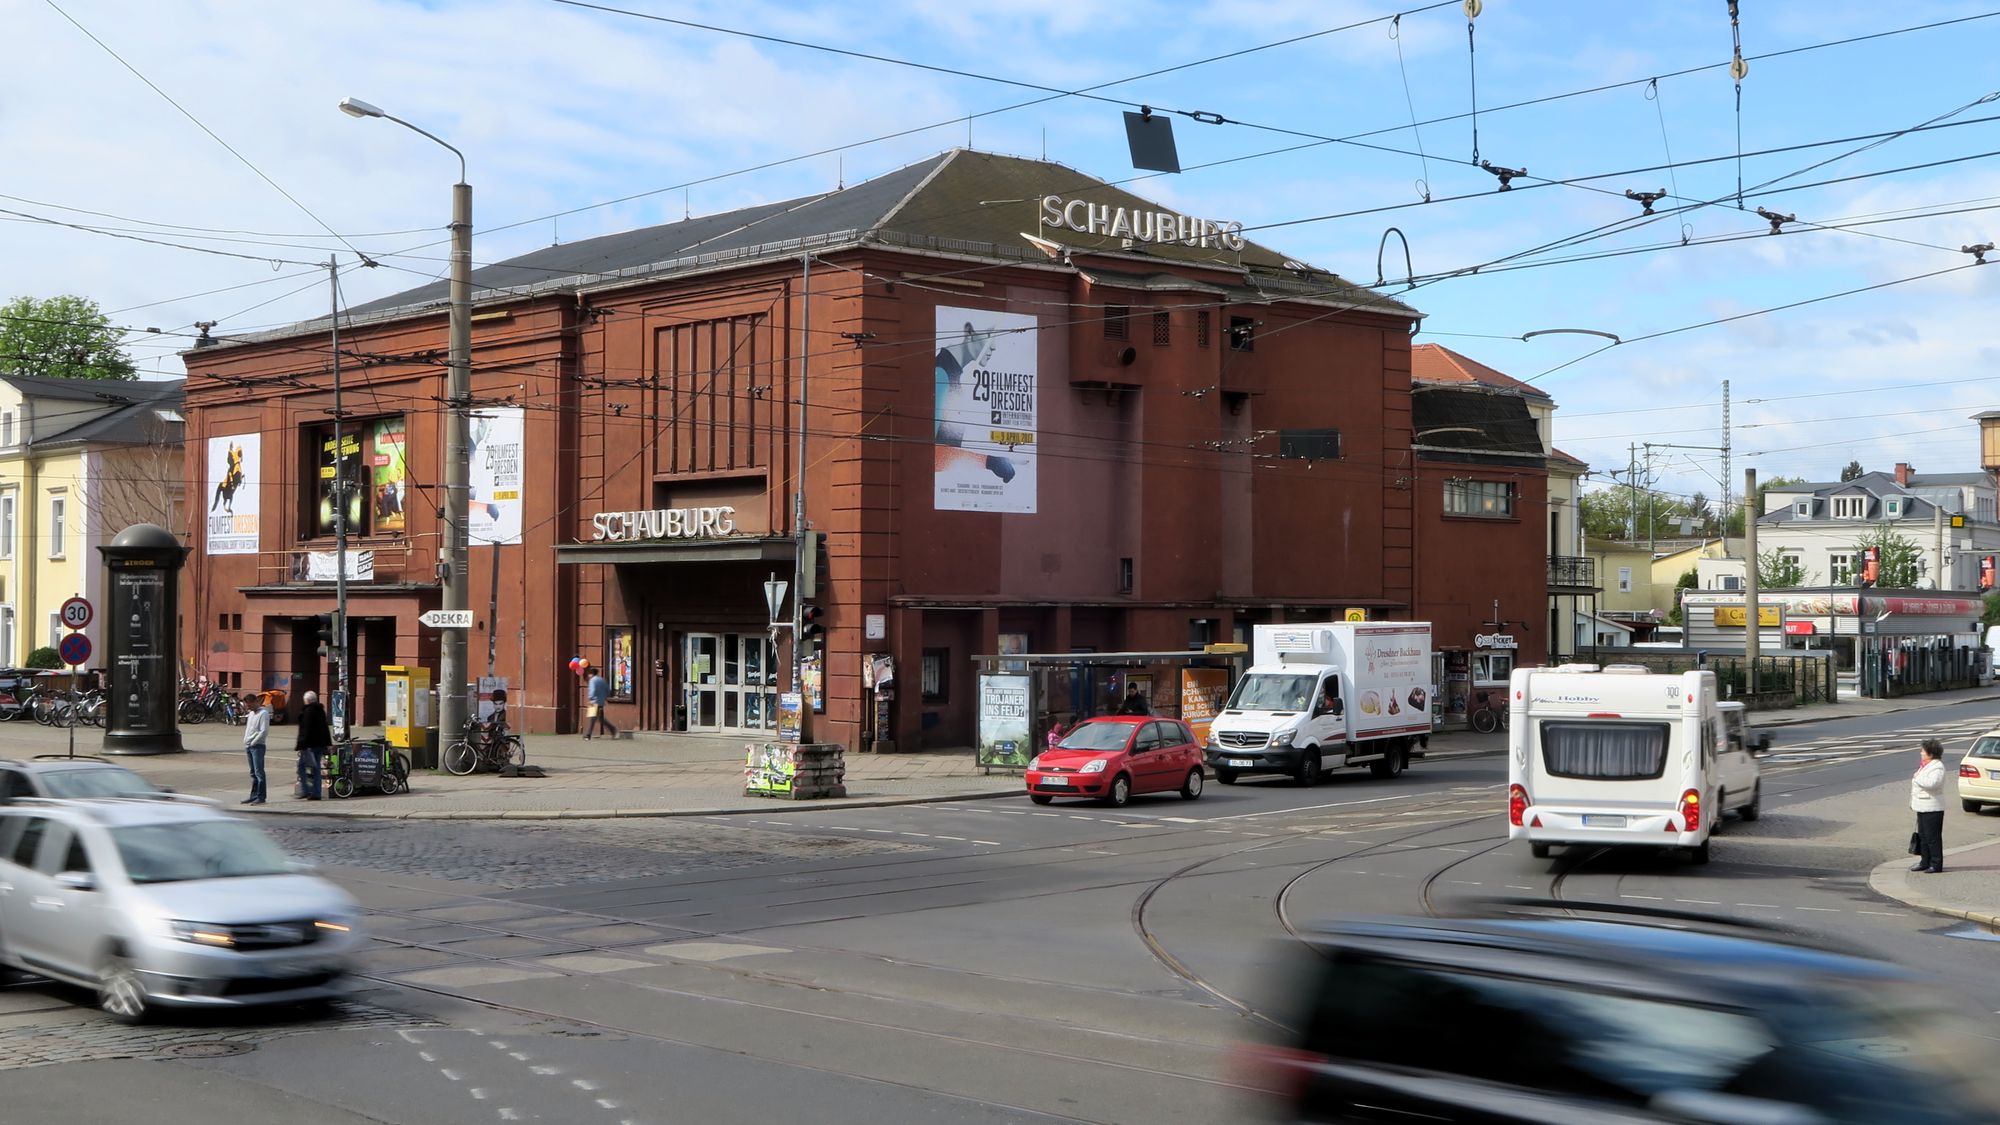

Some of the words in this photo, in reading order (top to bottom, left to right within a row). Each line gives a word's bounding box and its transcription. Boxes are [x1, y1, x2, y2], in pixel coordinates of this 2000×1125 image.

[1042, 195, 1245, 252] SCHAUBURG
[973, 369, 990, 402] 29
[991, 371, 1034, 393] FILMFEST
[991, 391, 1033, 412] DRESDEN
[485, 445, 495, 470] 29
[494, 443, 519, 459] FILMFEST
[494, 459, 518, 475] DRESDEN
[208, 515, 234, 535] FILMFEST
[234, 514, 257, 534] DRESDEN
[592, 506, 736, 541] SCHAUBURG
[67, 606, 86, 621] 30
[432, 613, 470, 624] DEKRA
[1183, 687, 1211, 696] SCHRITT
[1187, 680, 1199, 688] EIN
[986, 694, 1024, 705] TROJANER
[1188, 695, 1209, 704] KANN
[1558, 695, 1600, 703] Hobby
[985, 704, 999, 715] INS
[1001, 705, 1024, 717] FELD?
[1183, 709, 1210, 718] ZURÜCK
